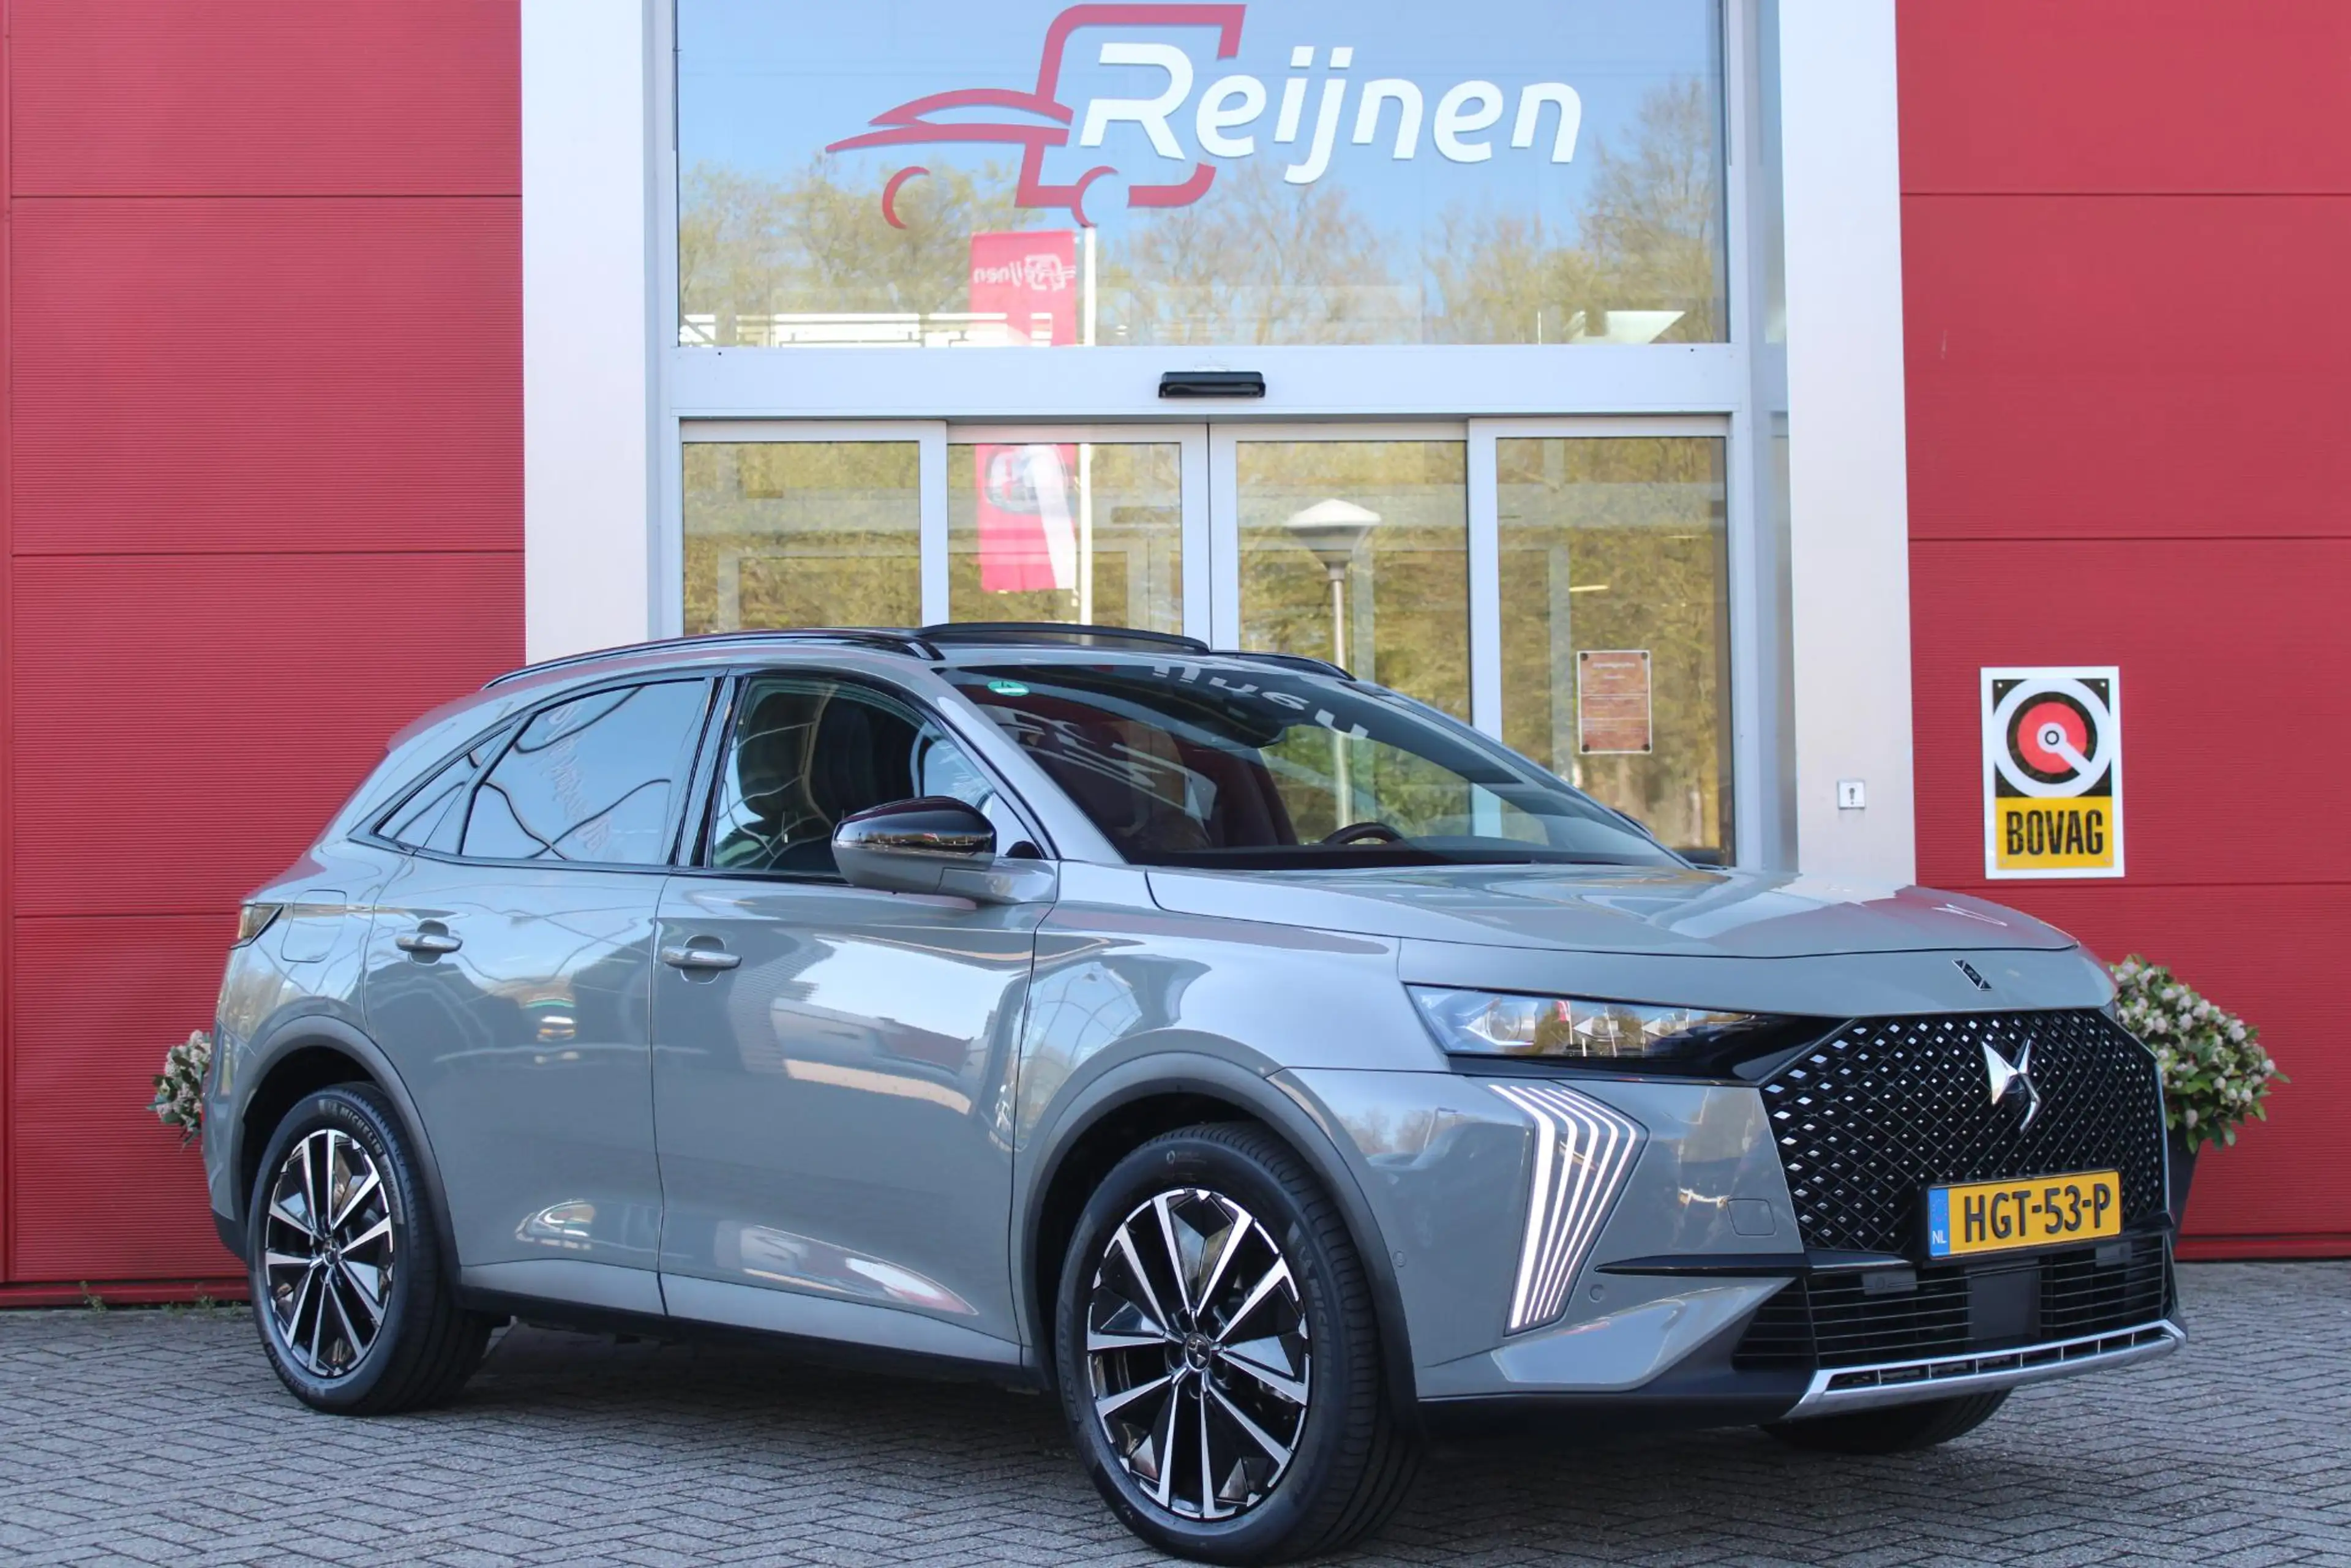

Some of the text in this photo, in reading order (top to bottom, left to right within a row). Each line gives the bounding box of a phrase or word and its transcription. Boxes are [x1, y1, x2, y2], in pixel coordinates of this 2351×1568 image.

[1079, 42, 1583, 184] Reijnen
[2006, 809, 2104, 855] BOVAG
[340, 1106, 383, 1155] MICHELIN
[1932, 1230, 1948, 1245] NL
[1964, 1183, 2111, 1243] HGT-53-P
